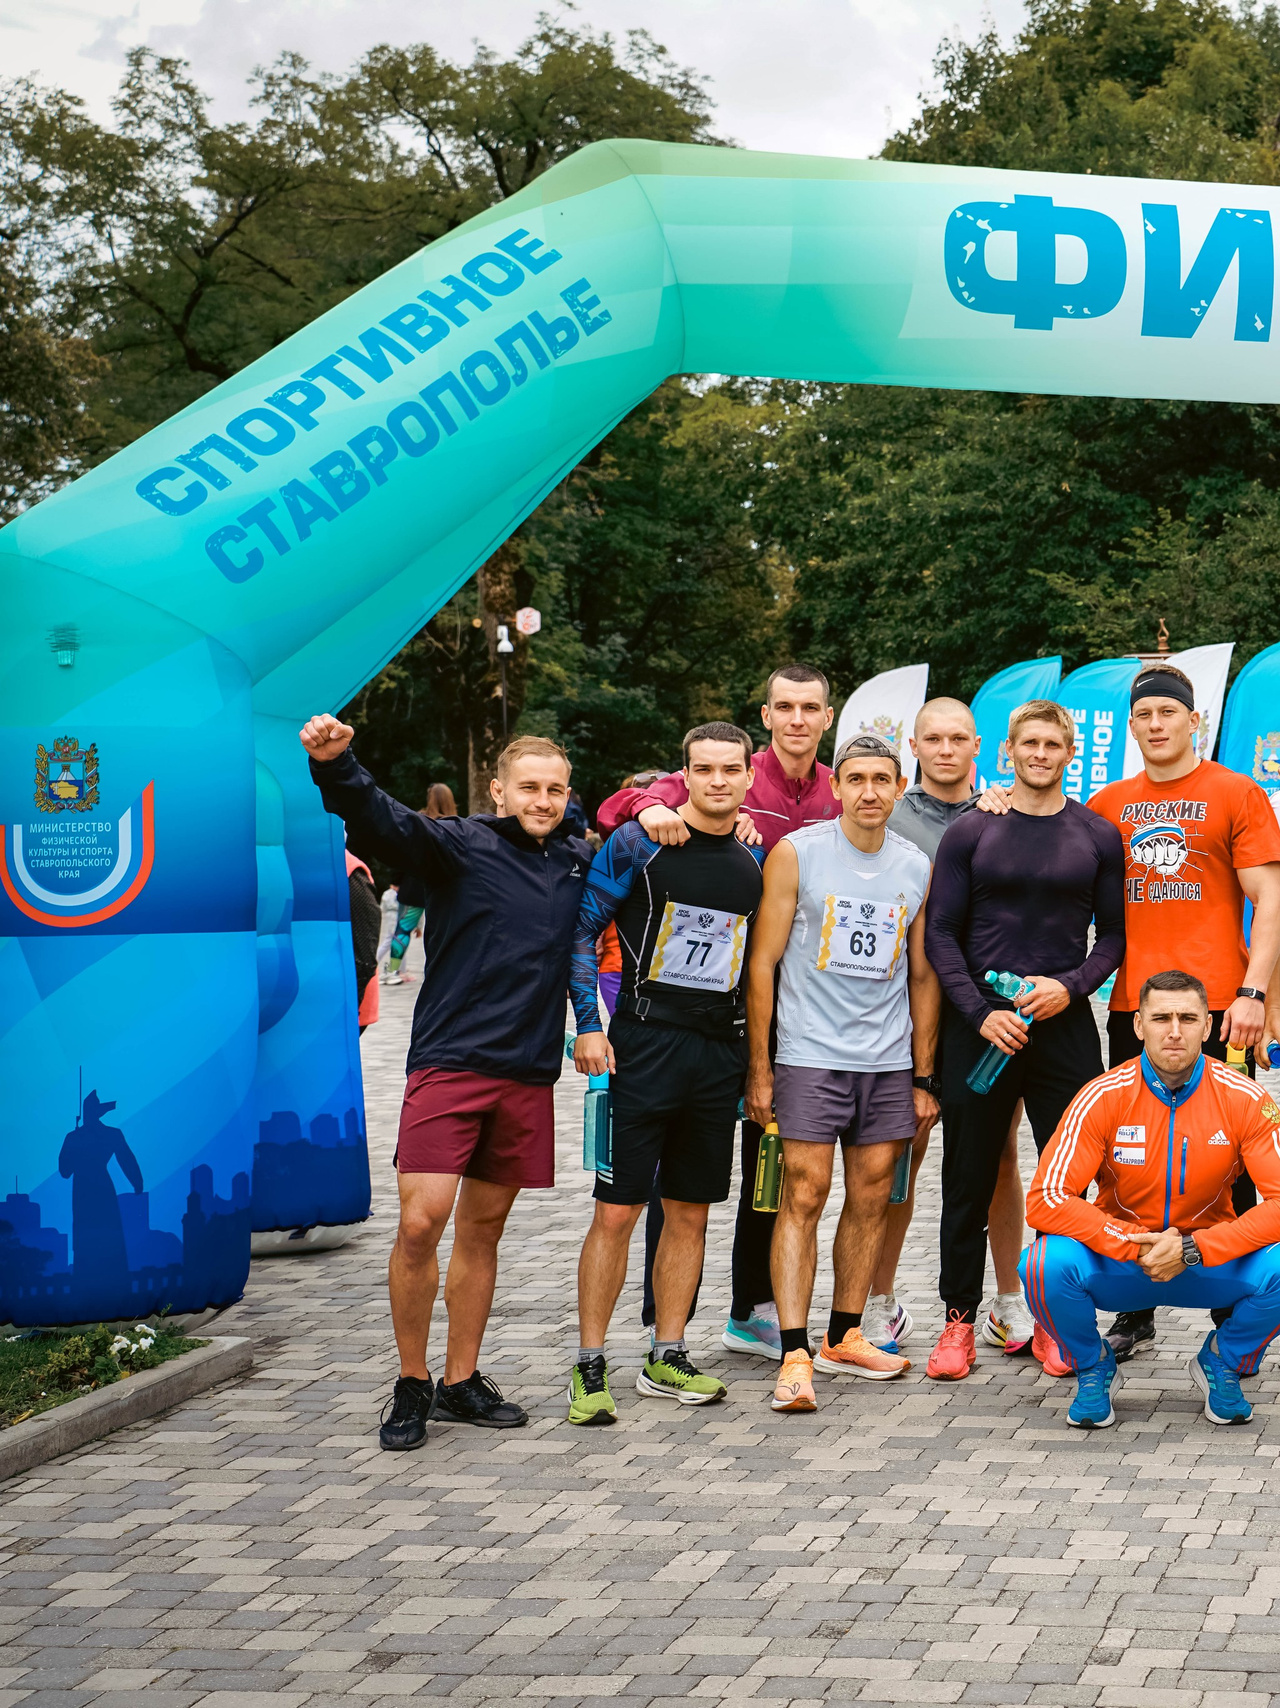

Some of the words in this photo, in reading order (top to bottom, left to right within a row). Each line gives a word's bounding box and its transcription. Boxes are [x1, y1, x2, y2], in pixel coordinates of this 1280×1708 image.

[135, 228, 562, 516] СПОРТИВНОЕ
[204, 277, 611, 584] СТАВРОПОЛЬЕ
[1120, 800, 1208, 823] РУССКИЕ
[29, 822, 112, 833] МИНИСТЕРСТВО
[41, 834, 98, 845] ФИЗИЧЕСКОЙ
[28, 848, 70, 857] КУЛЬТУРЫ
[71, 848, 78, 856] И
[80, 847, 113, 856] СПОРТА
[30, 858, 111, 868] СТАВРОПОЛЬСКОГО
[58, 870, 80, 879] КРАЯ
[1125, 877, 1145, 903] НЕ
[1148, 881, 1202, 903] СДАЮТСЯ
[850, 930, 876, 957] 63
[685, 939, 712, 967] 77
[830, 960, 876, 972] СТАВРОПОЛЬСКИЙ
[663, 970, 712, 983] СТАВРОПОЛЬСКИЙ
[711, 976, 724, 985] КРАЙ
